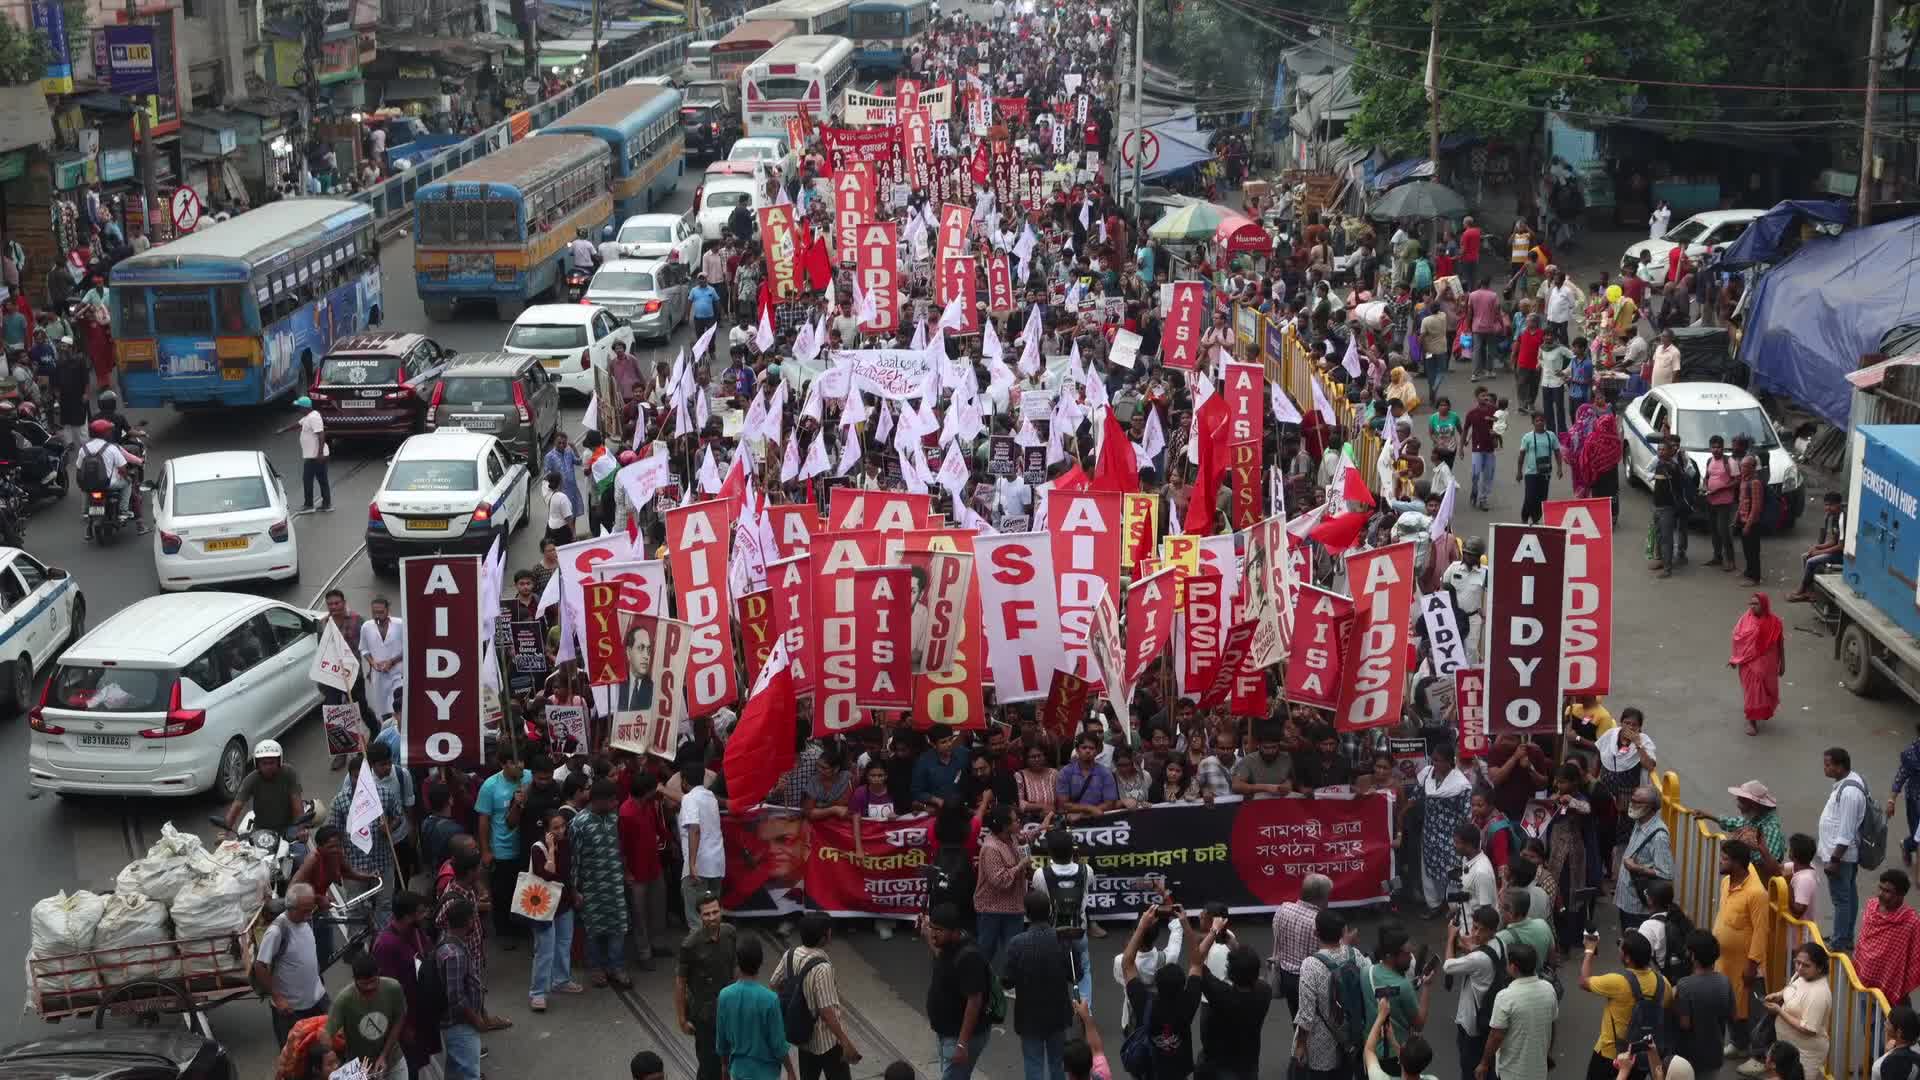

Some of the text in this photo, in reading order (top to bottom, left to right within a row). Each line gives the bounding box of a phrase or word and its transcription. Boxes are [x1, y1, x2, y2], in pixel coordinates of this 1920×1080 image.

[863, 226, 891, 329] AIDSO
[992, 256, 1008, 306] AISA
[1173, 286, 1195, 361] AISA
[1899, 489, 1918, 520] HIRE
[592, 586, 619, 683] DYSA
[680, 511, 728, 705] AIDSO
[820, 539, 866, 730] AIDSO
[871, 577, 896, 693] AISA
[925, 557, 961, 671] PSU
[991, 544, 1041, 693] SFI
[1060, 498, 1109, 683] AIDSO
[1189, 582, 1218, 675] PDSF
[1347, 555, 1400, 723] AIDSO
[1504, 534, 1548, 728] AIDYO
[1559, 506, 1601, 690] AIDSO
[423, 564, 463, 762] AIDYO
[653, 624, 681, 754] PSU
[1301, 596, 1335, 696] AISA
[1461, 676, 1485, 750] AIDSO
[1096, 847, 1187, 867] অপসারণ
[1194, 842, 1229, 862] চাই
[1256, 839, 1365, 857] সংগঠন সমূহ
[1258, 819, 1363, 840] বামপন্থী ছাত্র
[1263, 860, 1367, 876] ও ছাত্রসমাজ
